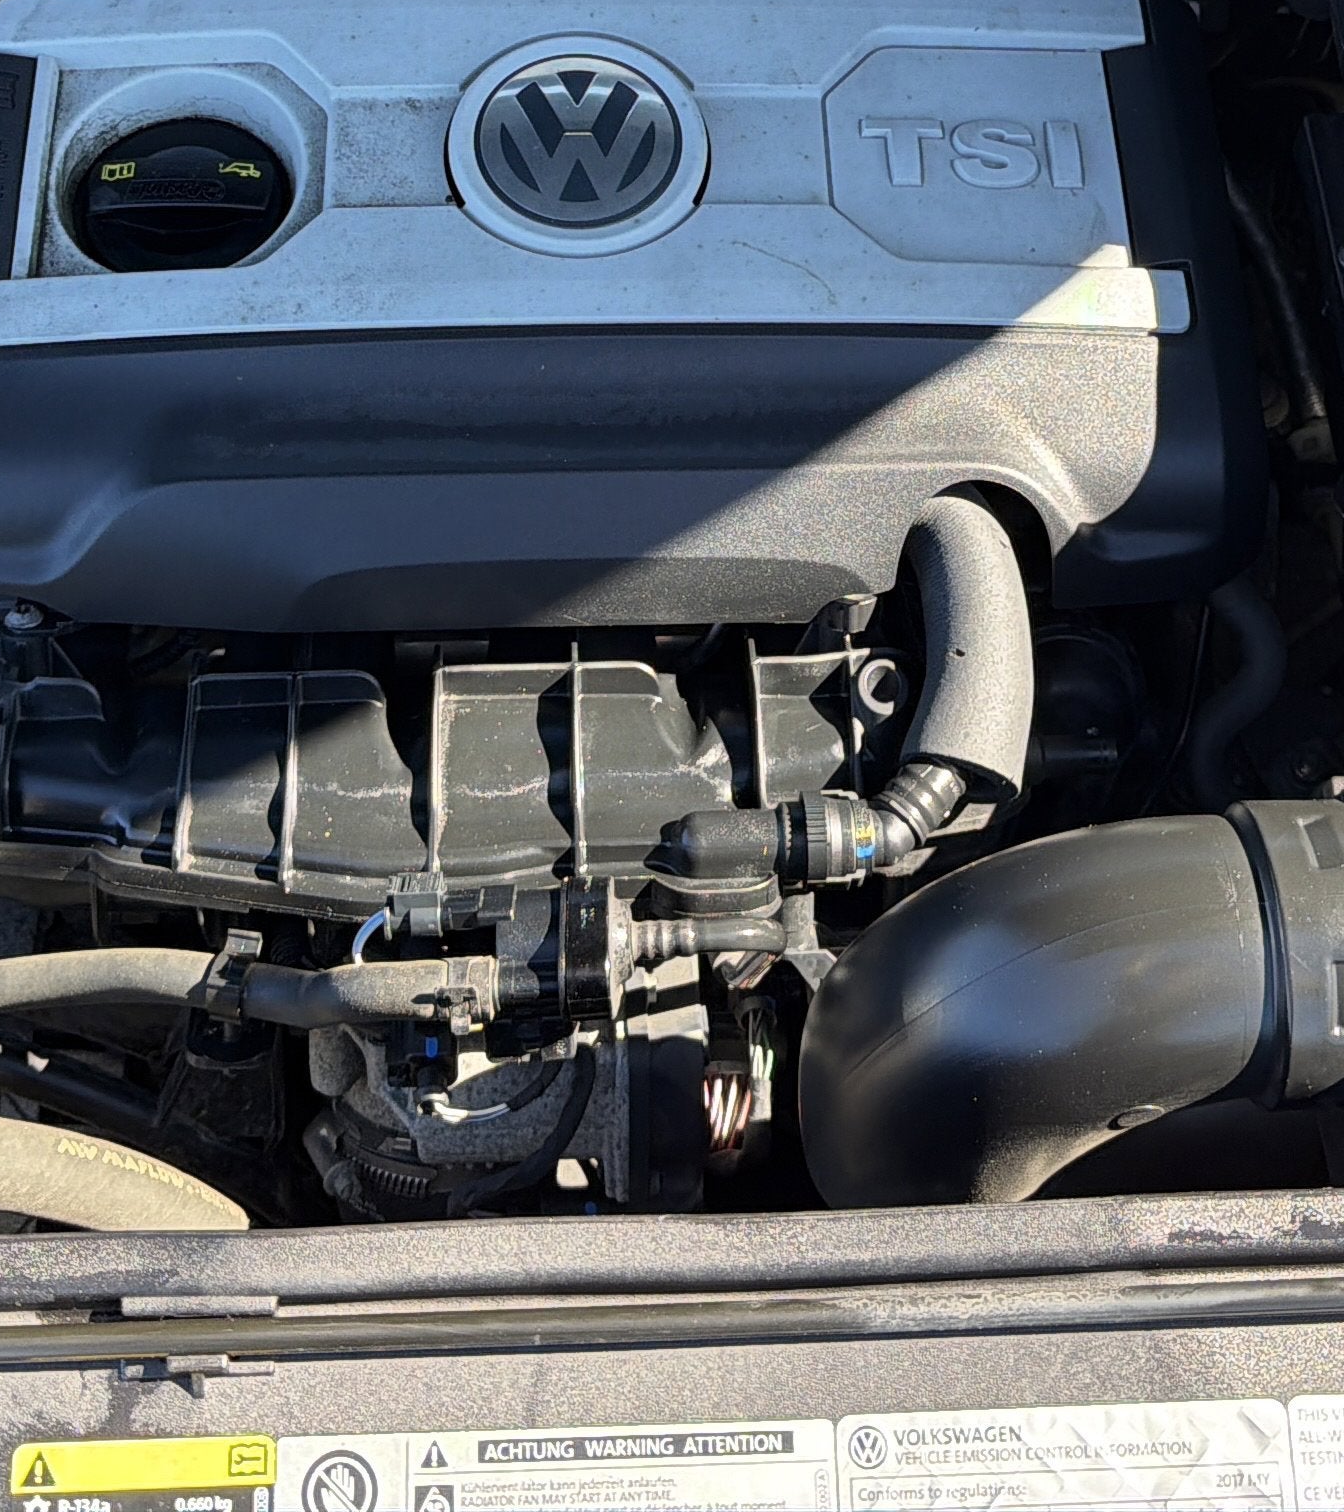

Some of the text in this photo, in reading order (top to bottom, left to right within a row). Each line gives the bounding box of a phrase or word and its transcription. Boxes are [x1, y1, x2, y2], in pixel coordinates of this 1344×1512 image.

[480, 54, 682, 228] VW
[858, 117, 1086, 193] TSI
[1298, 1407, 1328, 1422] THIS
[893, 1425, 1023, 1446] VOLKSWAGEN
[484, 1433, 783, 1461] ACHTUNG WARNING ATTENTION
[955, 1447, 1022, 1464] EMISSION
[1025, 1444, 1092, 1462] CONTROL
[460, 1495, 515, 1507] RADIATOR
[518, 1494, 538, 1506] FAN
[542, 1493, 567, 1506] MAY
[569, 1492, 601, 1504] START
[858, 1486, 924, 1502] Conforms
